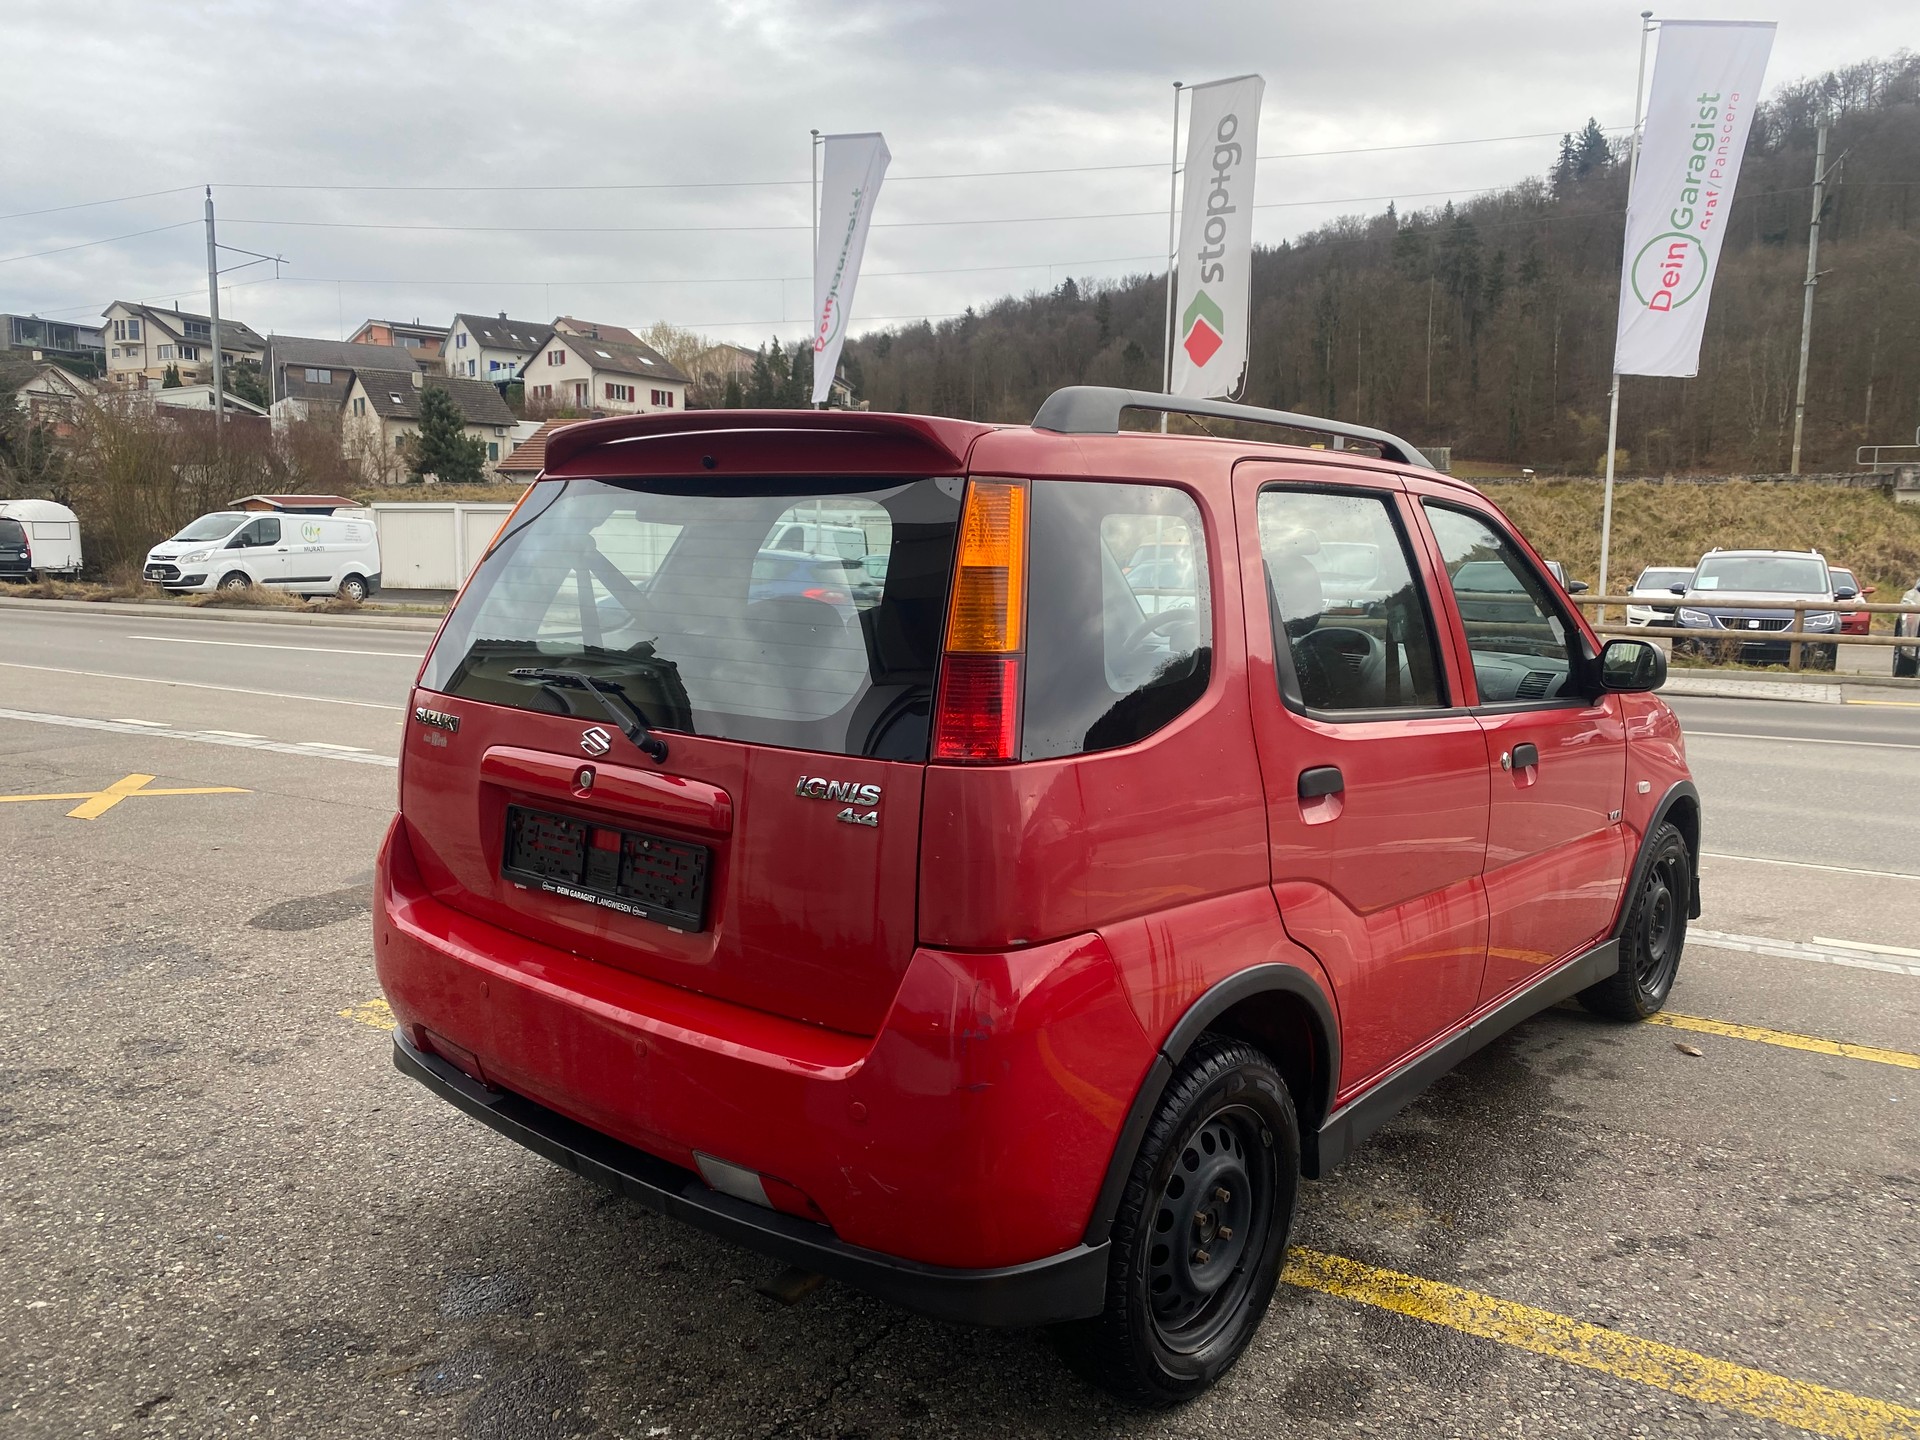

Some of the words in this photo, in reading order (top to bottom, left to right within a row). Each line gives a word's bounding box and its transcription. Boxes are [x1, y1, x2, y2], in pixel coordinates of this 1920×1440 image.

[1198, 113, 1242, 283] stop+go
[1649, 243, 1688, 312] Dein
[1670, 92, 1720, 230] Garagist
[415, 706, 460, 733] SUZUKI
[796, 775, 881, 807] IGNIS
[836, 806, 878, 827] 4x4
[556, 886, 569, 896] DEIN
[569, 889, 596, 902] GARAGIST
[597, 897, 631, 913] LANGWIESEN
